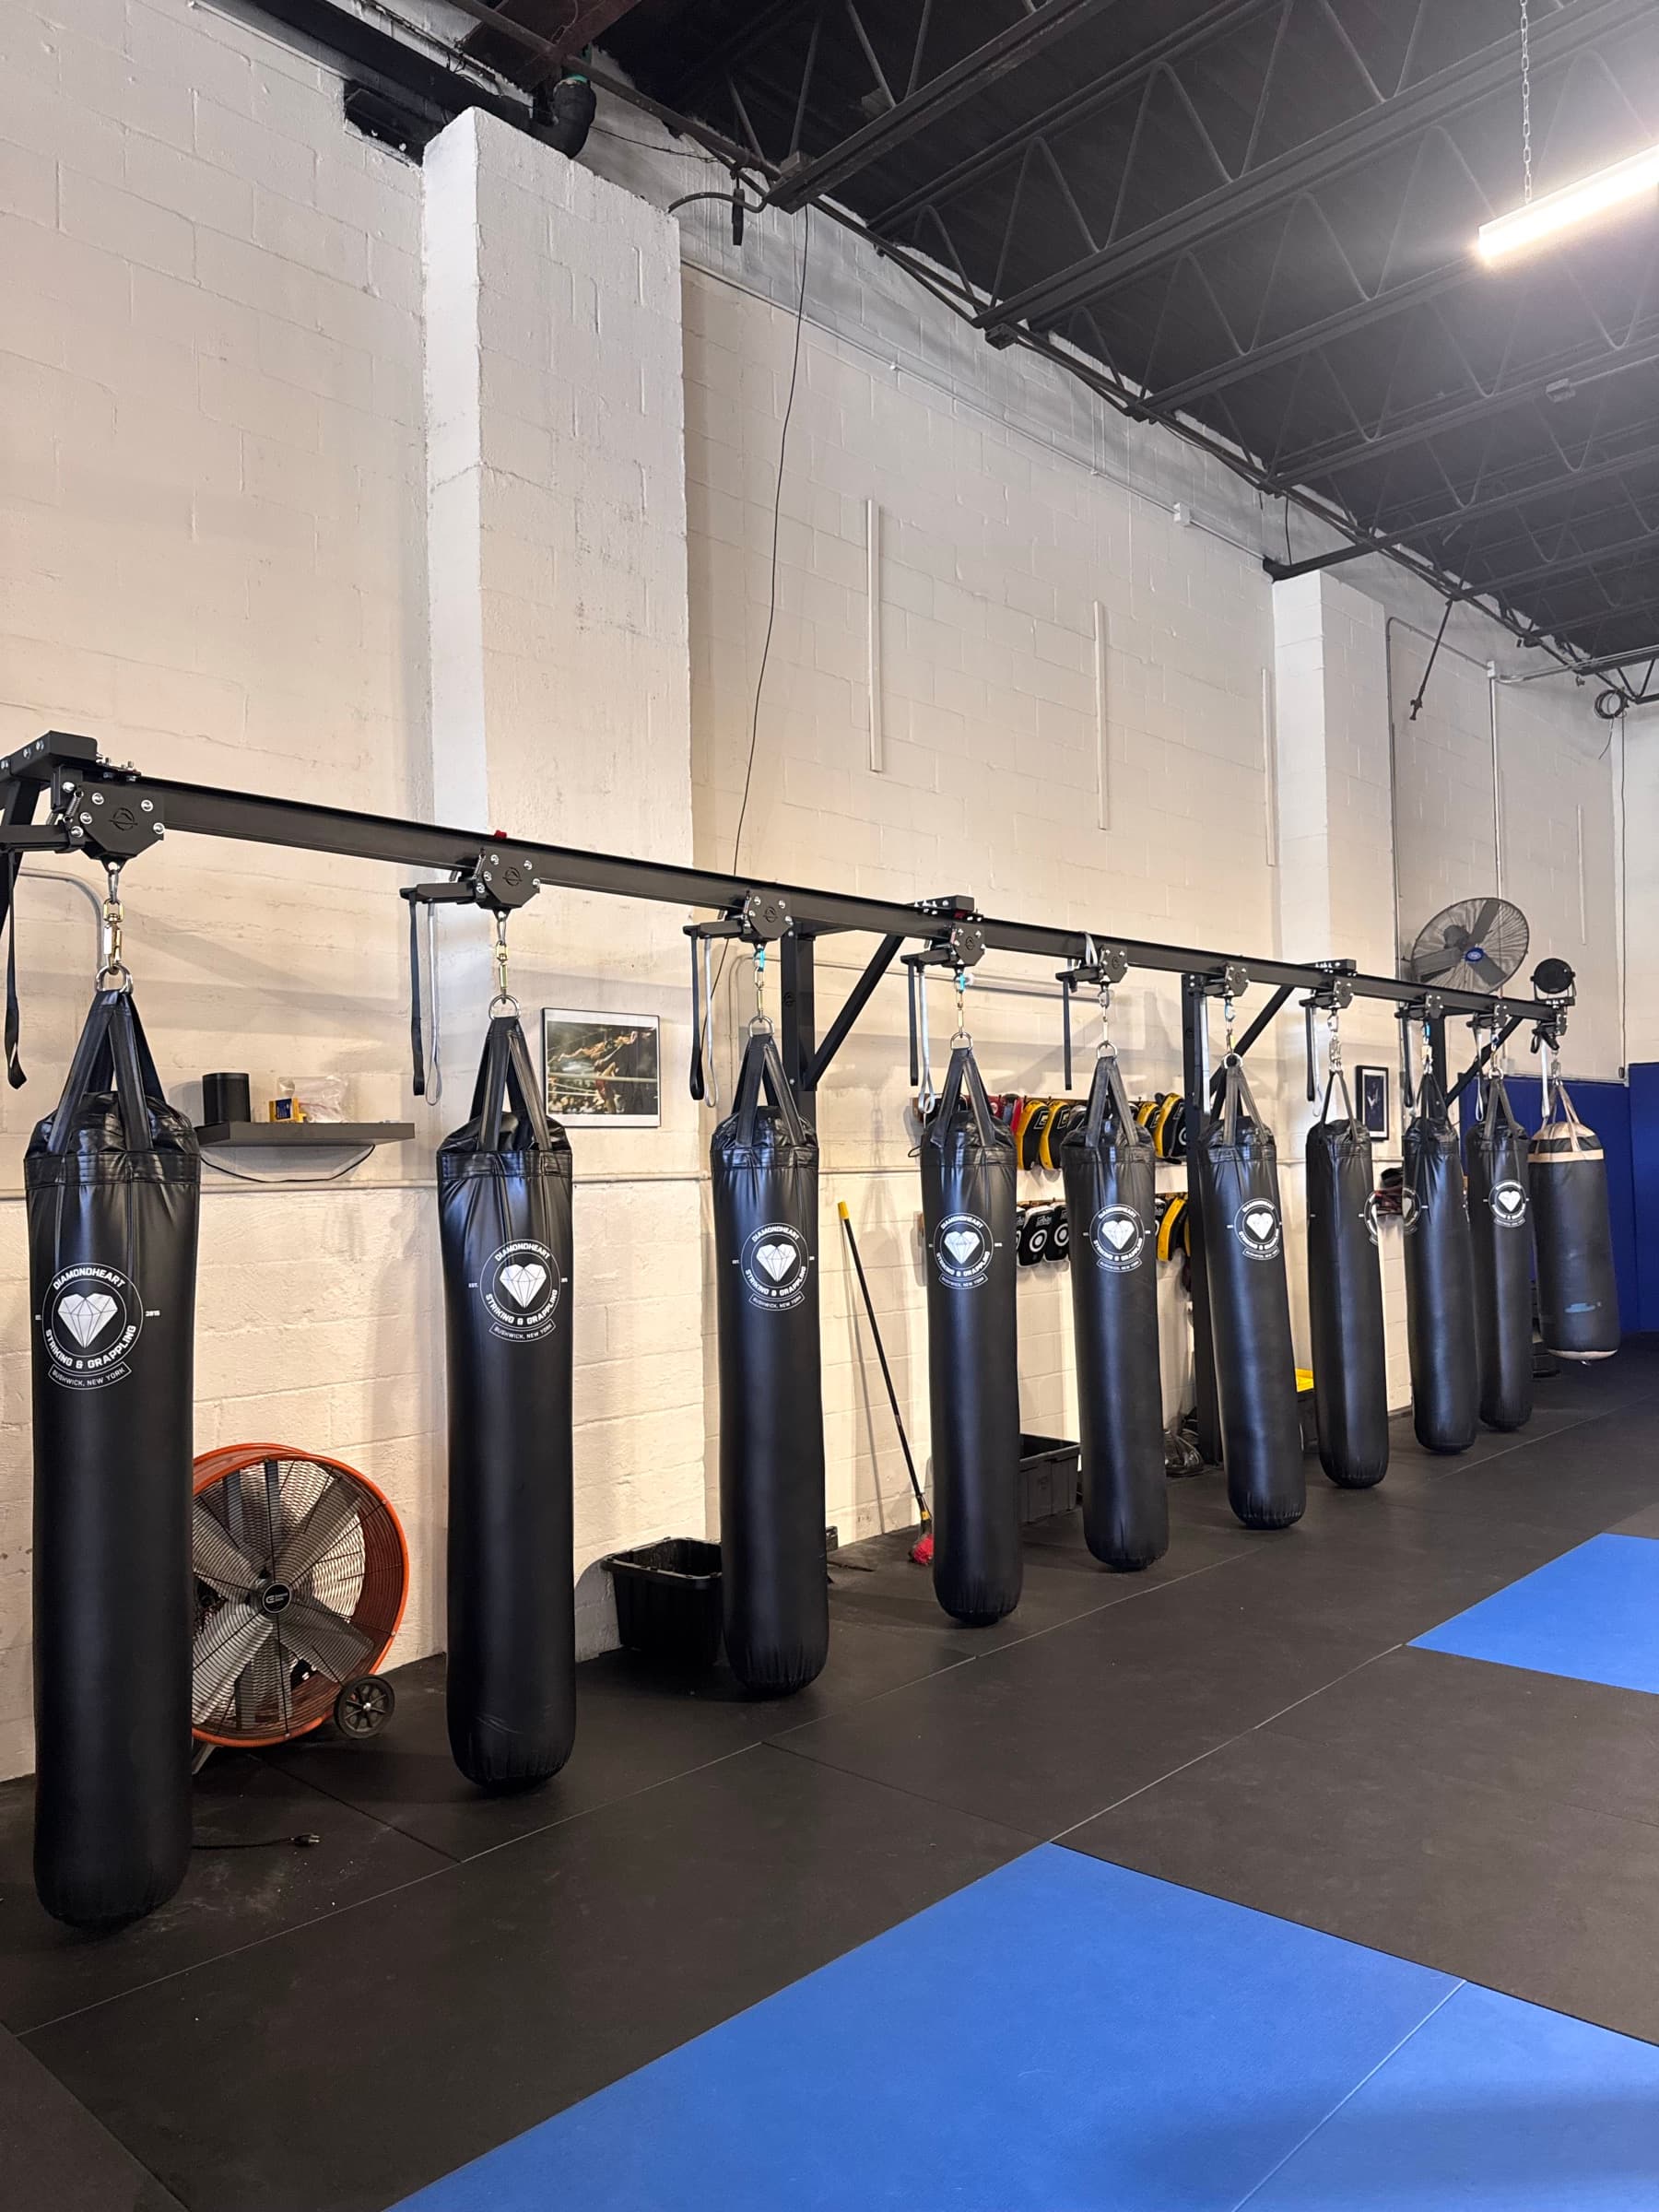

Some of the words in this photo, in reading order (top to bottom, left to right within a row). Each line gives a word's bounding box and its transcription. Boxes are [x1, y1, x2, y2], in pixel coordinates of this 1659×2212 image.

[751, 1226, 800, 1243] DIAMONDHEART
[494, 1242, 551, 1262] DIAMONDHEART
[53, 1267, 126, 1290] DIAMONDHEART
[745, 1268, 770, 1295] STRIKING
[486, 1293, 515, 1324] STRIKING
[517, 1318, 524, 1326] &
[526, 1288, 559, 1325] GRAPPLING
[45, 1329, 73, 1367] STRIKING
[76, 1360, 83, 1369] &
[88, 1324, 137, 1369] GRAPPLING
[87, 1377, 104, 1386] NEW
[106, 1367, 125, 1382] YORK
